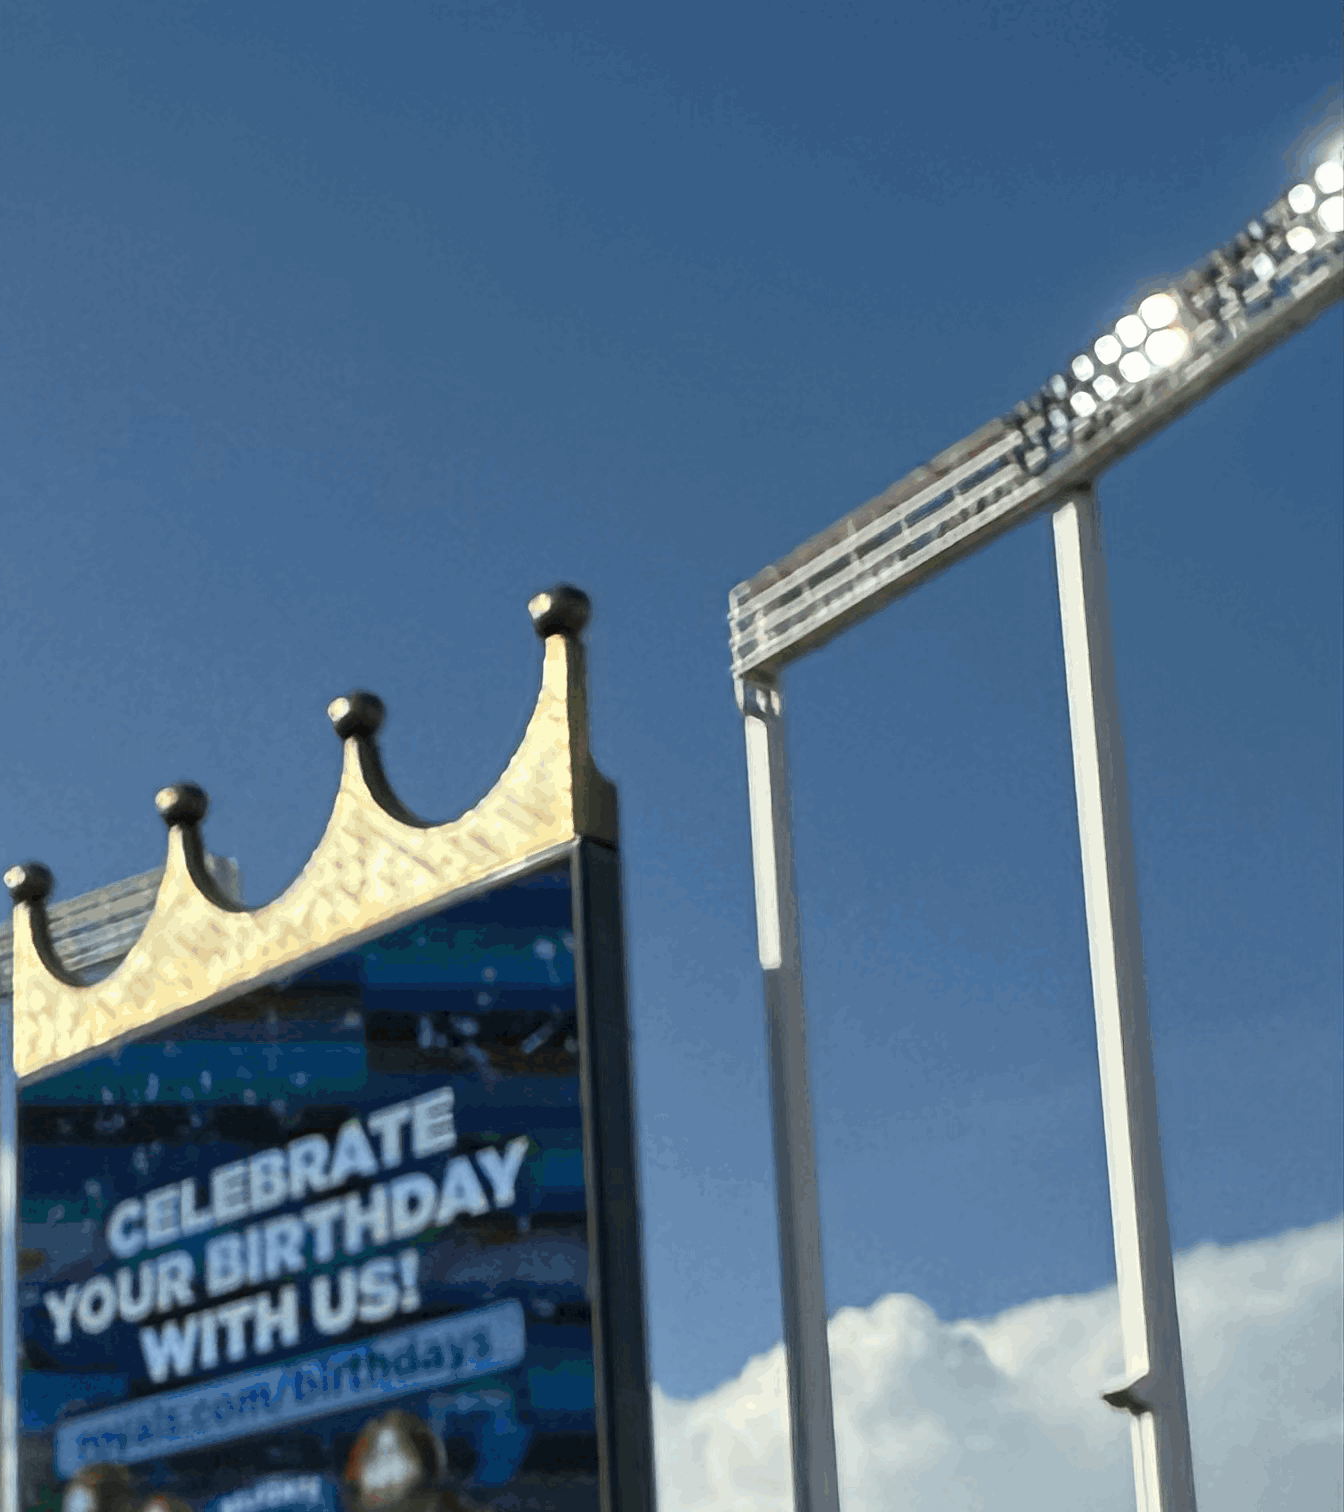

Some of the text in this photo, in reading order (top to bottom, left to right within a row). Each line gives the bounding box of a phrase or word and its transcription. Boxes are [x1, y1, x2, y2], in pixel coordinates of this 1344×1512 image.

[45, 1136, 529, 1343] YOUR BIRTHDAY
[108, 1086, 456, 1258] CELEBRATE
[141, 1250, 420, 1383] WITH US!
